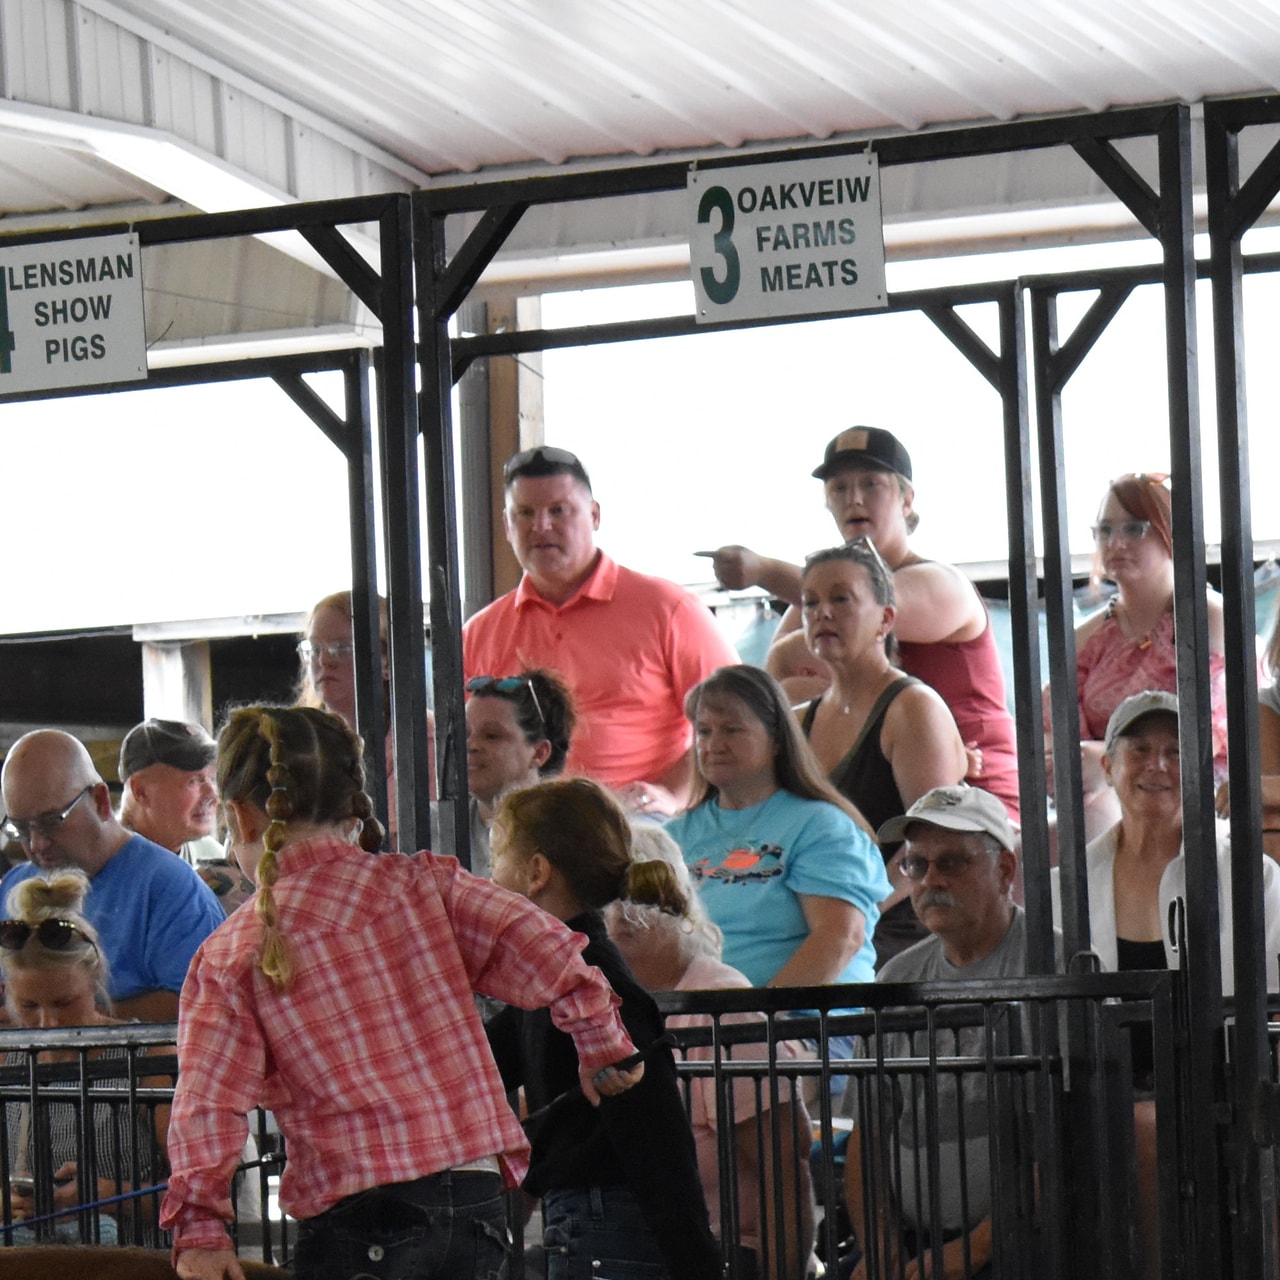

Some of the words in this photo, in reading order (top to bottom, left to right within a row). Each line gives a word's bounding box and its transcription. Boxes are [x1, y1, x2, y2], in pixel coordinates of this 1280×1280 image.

[737, 176, 871, 213] OAKVEIW
[698, 185, 741, 305] 3
[756, 218, 856, 252] FARMS
[8, 253, 134, 291] LENSMAN
[760, 258, 858, 293] MEATS
[34, 294, 112, 327] SHOW
[45, 333, 106, 364] PIGS
